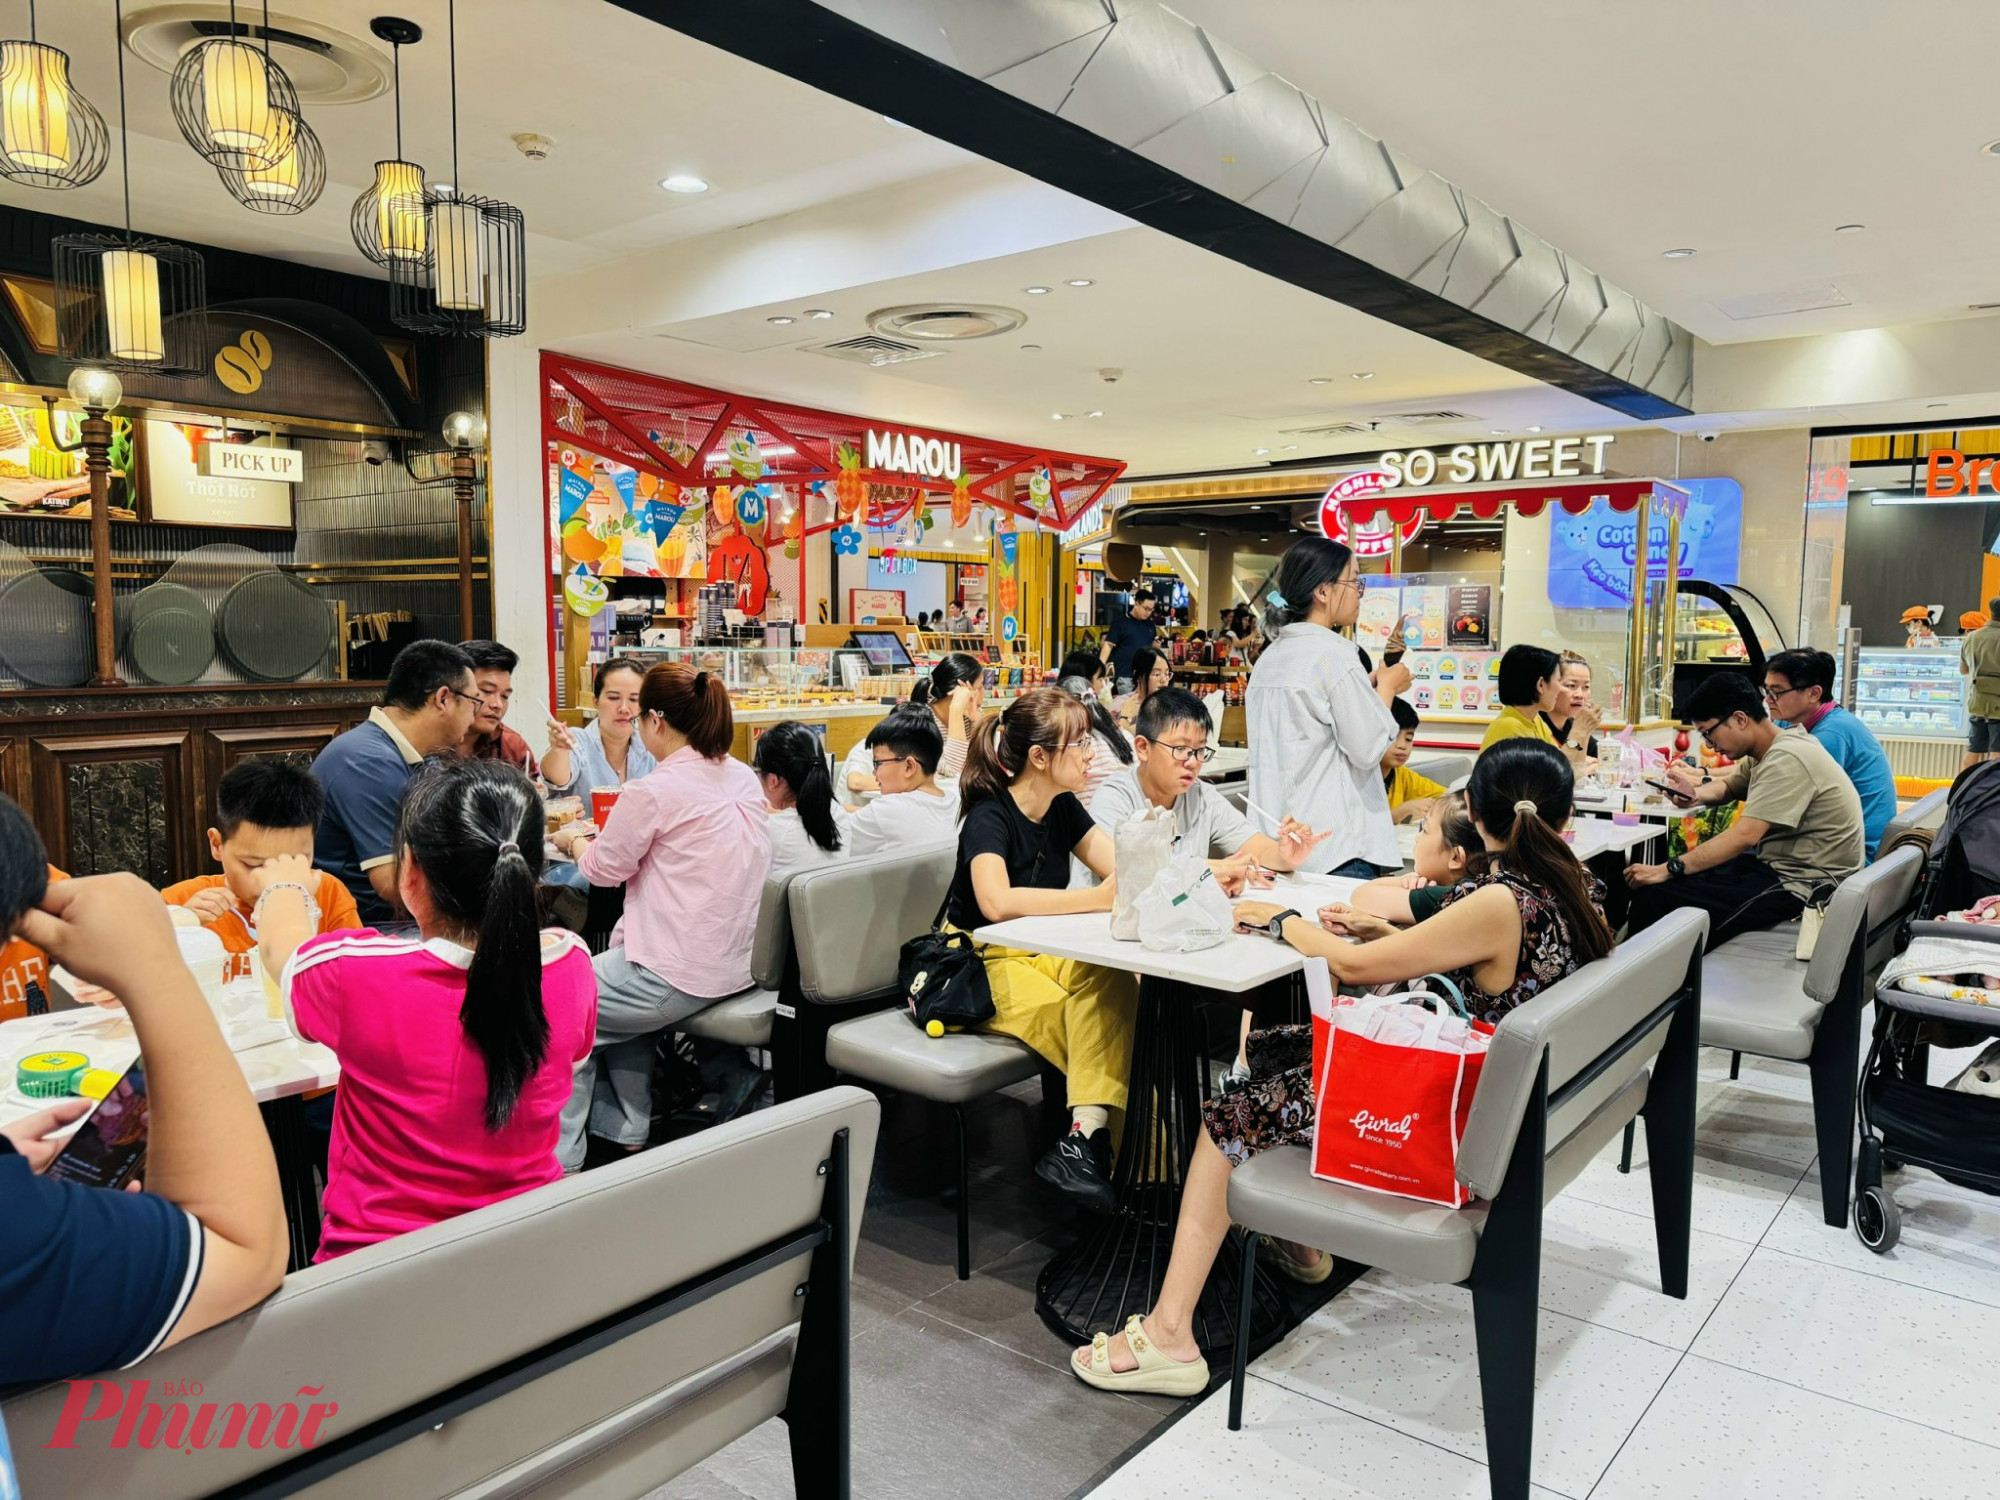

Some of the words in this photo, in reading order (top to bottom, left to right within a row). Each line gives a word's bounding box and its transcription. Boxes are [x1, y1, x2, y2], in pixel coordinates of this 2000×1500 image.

[222, 452, 264, 471] PICK
[271, 457, 292, 473] UP
[867, 428, 961, 480] MAROU
[1379, 448, 1437, 488] SO
[1449, 434, 1614, 484] SWEET
[744, 496, 758, 518] M
[655, 513, 676, 523] MAROU
[1599, 526, 1664, 544] Cottn
[1365, 1134, 1383, 1143] since
[1385, 1138, 1402, 1149] 1950
